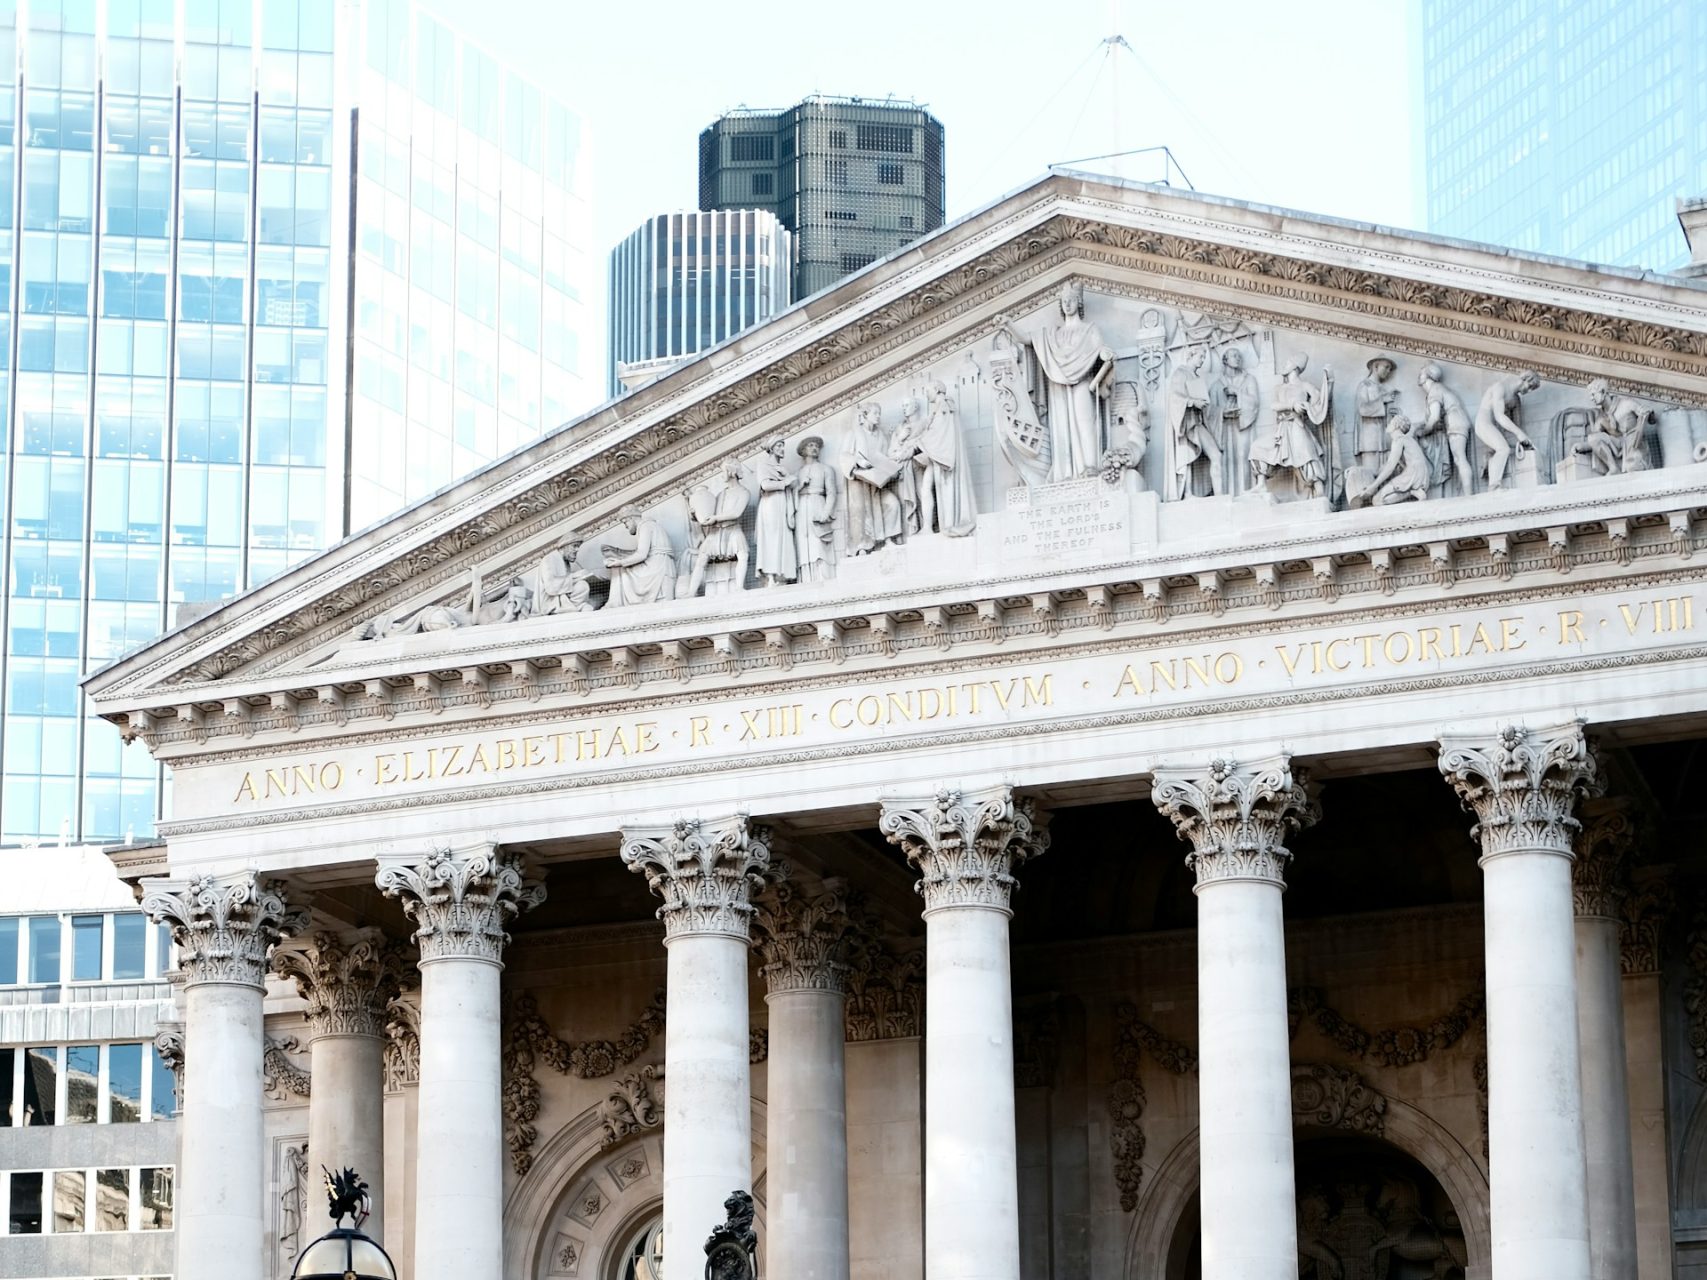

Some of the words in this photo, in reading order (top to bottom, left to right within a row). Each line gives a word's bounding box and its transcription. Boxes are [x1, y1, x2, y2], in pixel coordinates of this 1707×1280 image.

[232, 760, 346, 803] ANNO
[374, 721, 661, 785] ELIZABETHAE
[690, 715, 714, 748] R
[738, 703, 805, 742] XIII
[829, 673, 1055, 730] CONDITVM
[1112, 651, 1245, 699] ANNO
[1274, 615, 1528, 676] VICTORIAE
[1557, 609, 1589, 645] R
[1617, 595, 1694, 636] VIII
